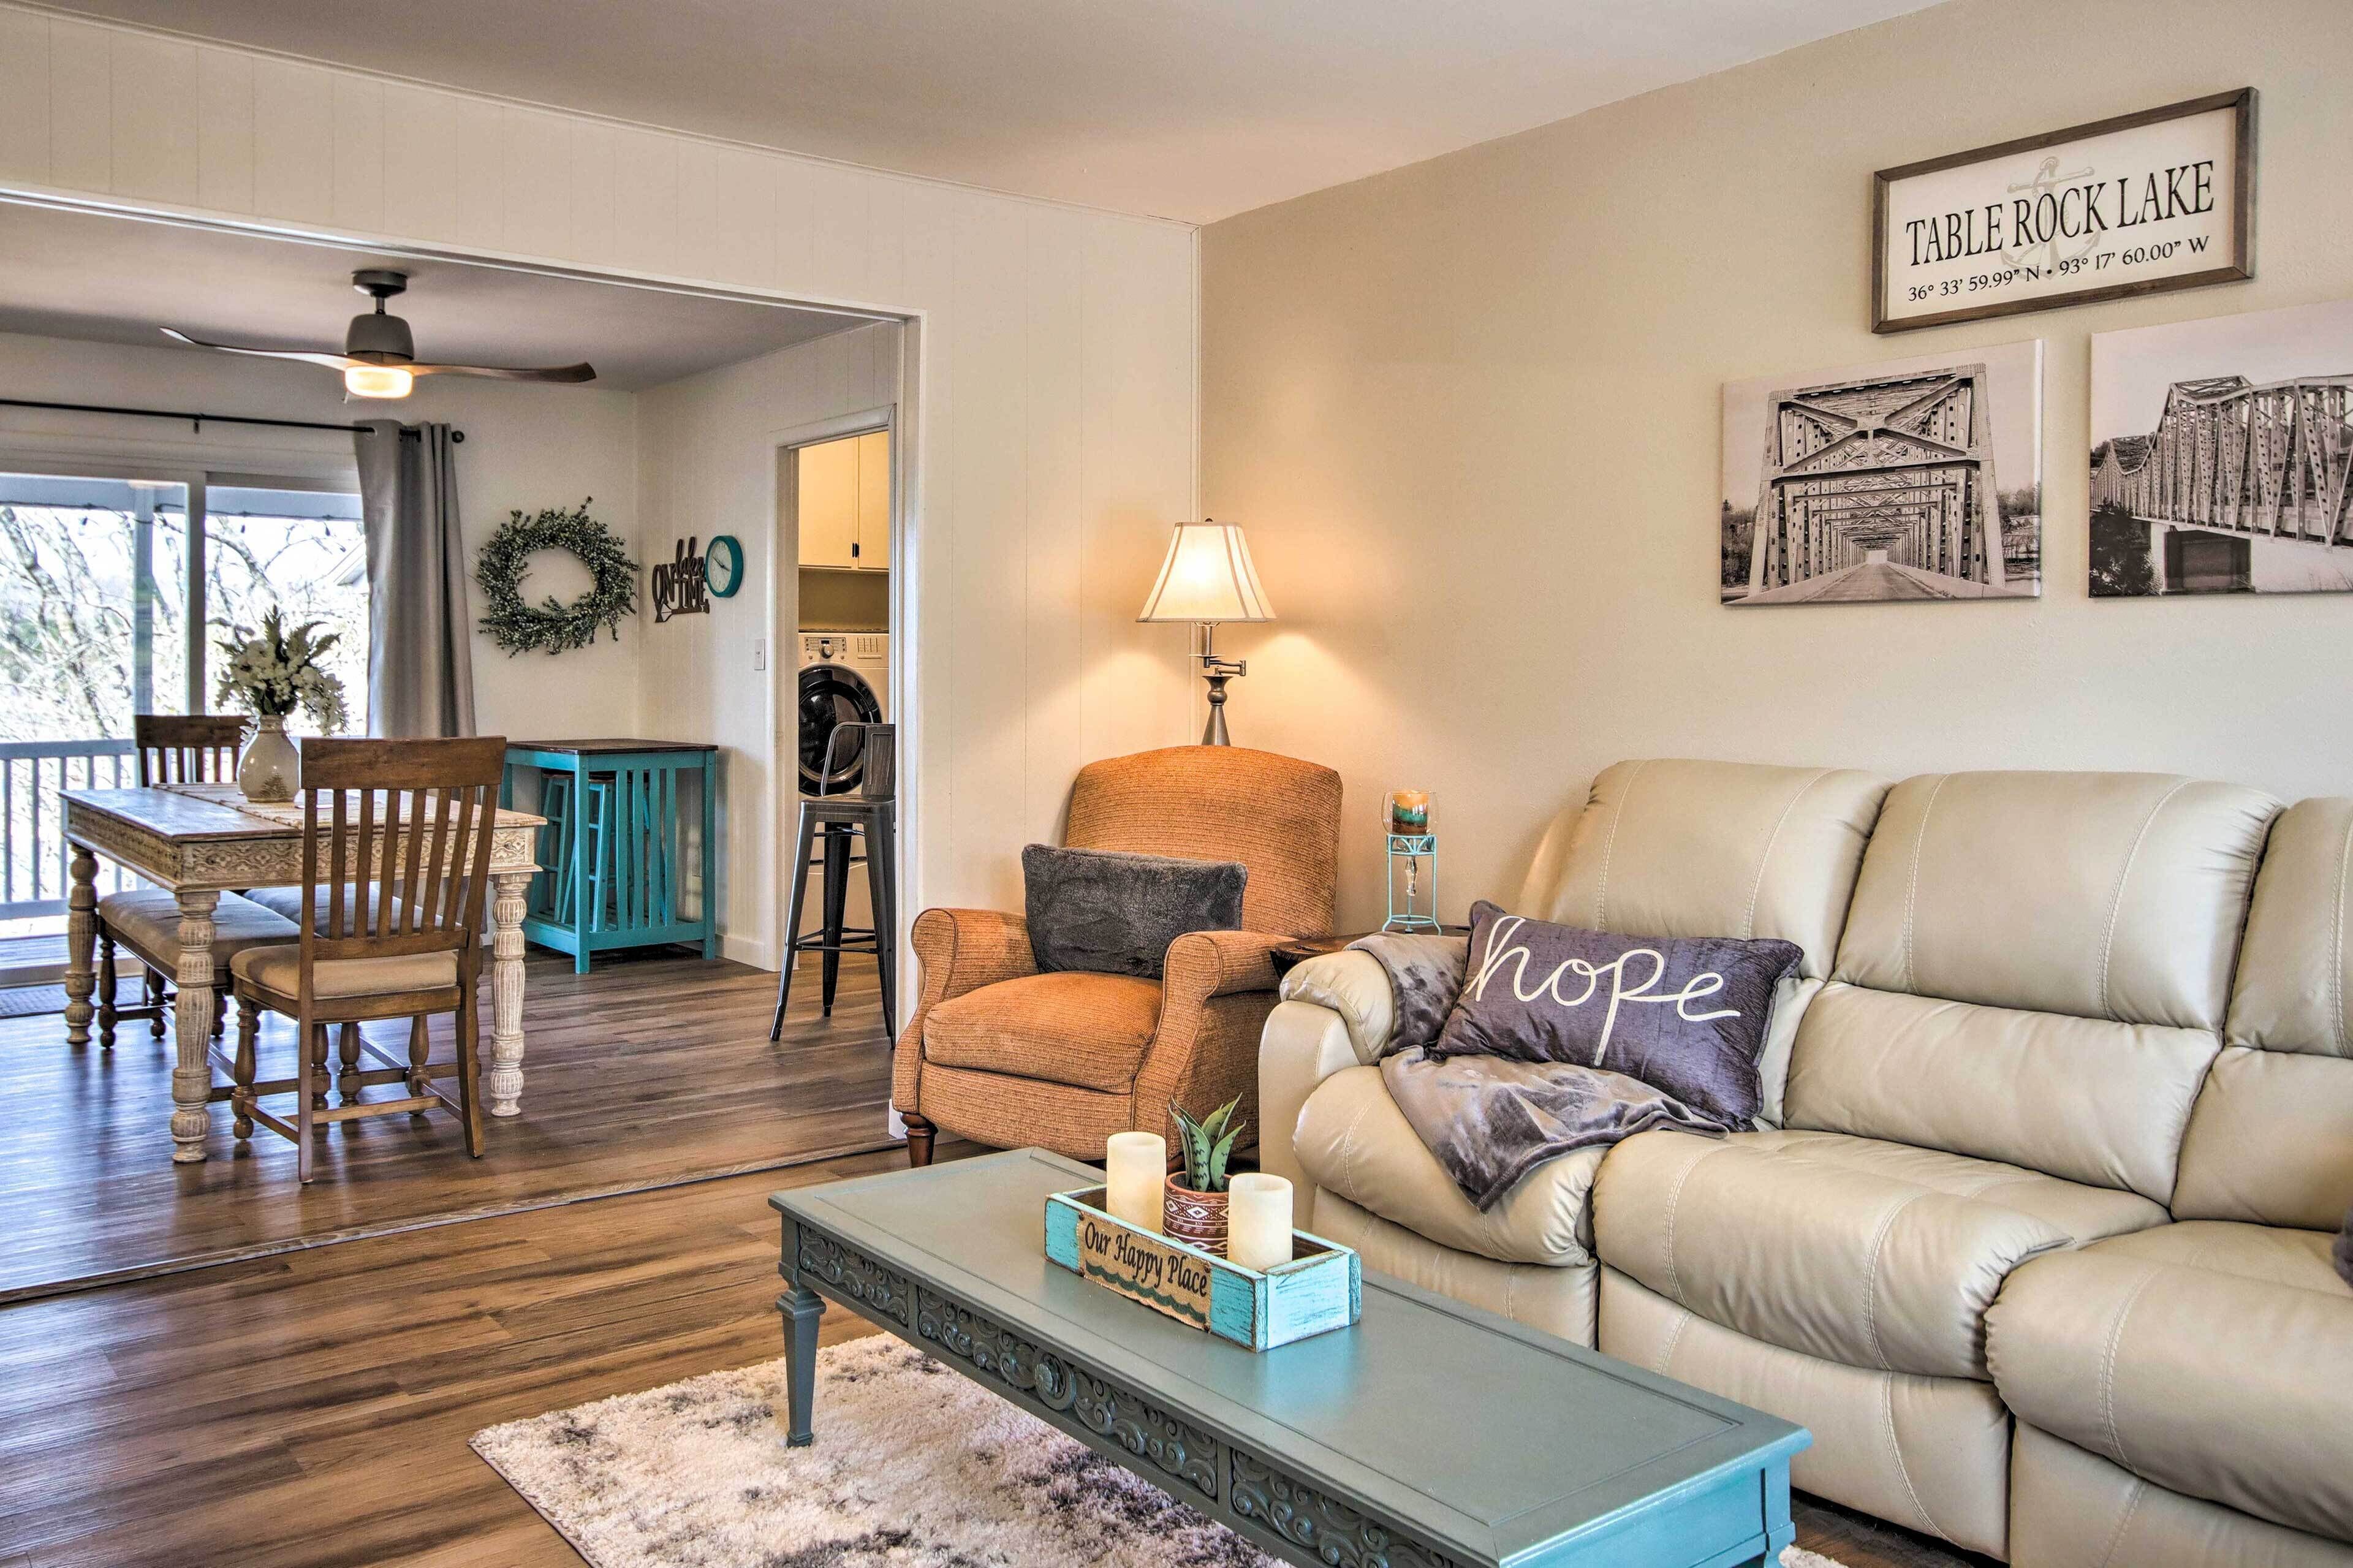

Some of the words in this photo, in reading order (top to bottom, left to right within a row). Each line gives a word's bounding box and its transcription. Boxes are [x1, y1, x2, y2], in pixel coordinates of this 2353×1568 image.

[1906, 203, 2003, 266] TABLE
[2013, 182, 2109, 248] ROCK
[2117, 160, 2214, 229] LAKE
[1909, 285, 1934, 301] 36°
[2026, 265, 2039, 282] N
[2059, 258, 2088, 276] 93°
[2188, 236, 2209, 253] W
[652, 563, 676, 604] ON
[673, 577, 707, 608] TIME
[1465, 915, 1741, 1066] hope
[1085, 1221, 1111, 1256] Our
[1114, 1232, 1163, 1287] Happy
[1167, 1254, 1208, 1297] Place
